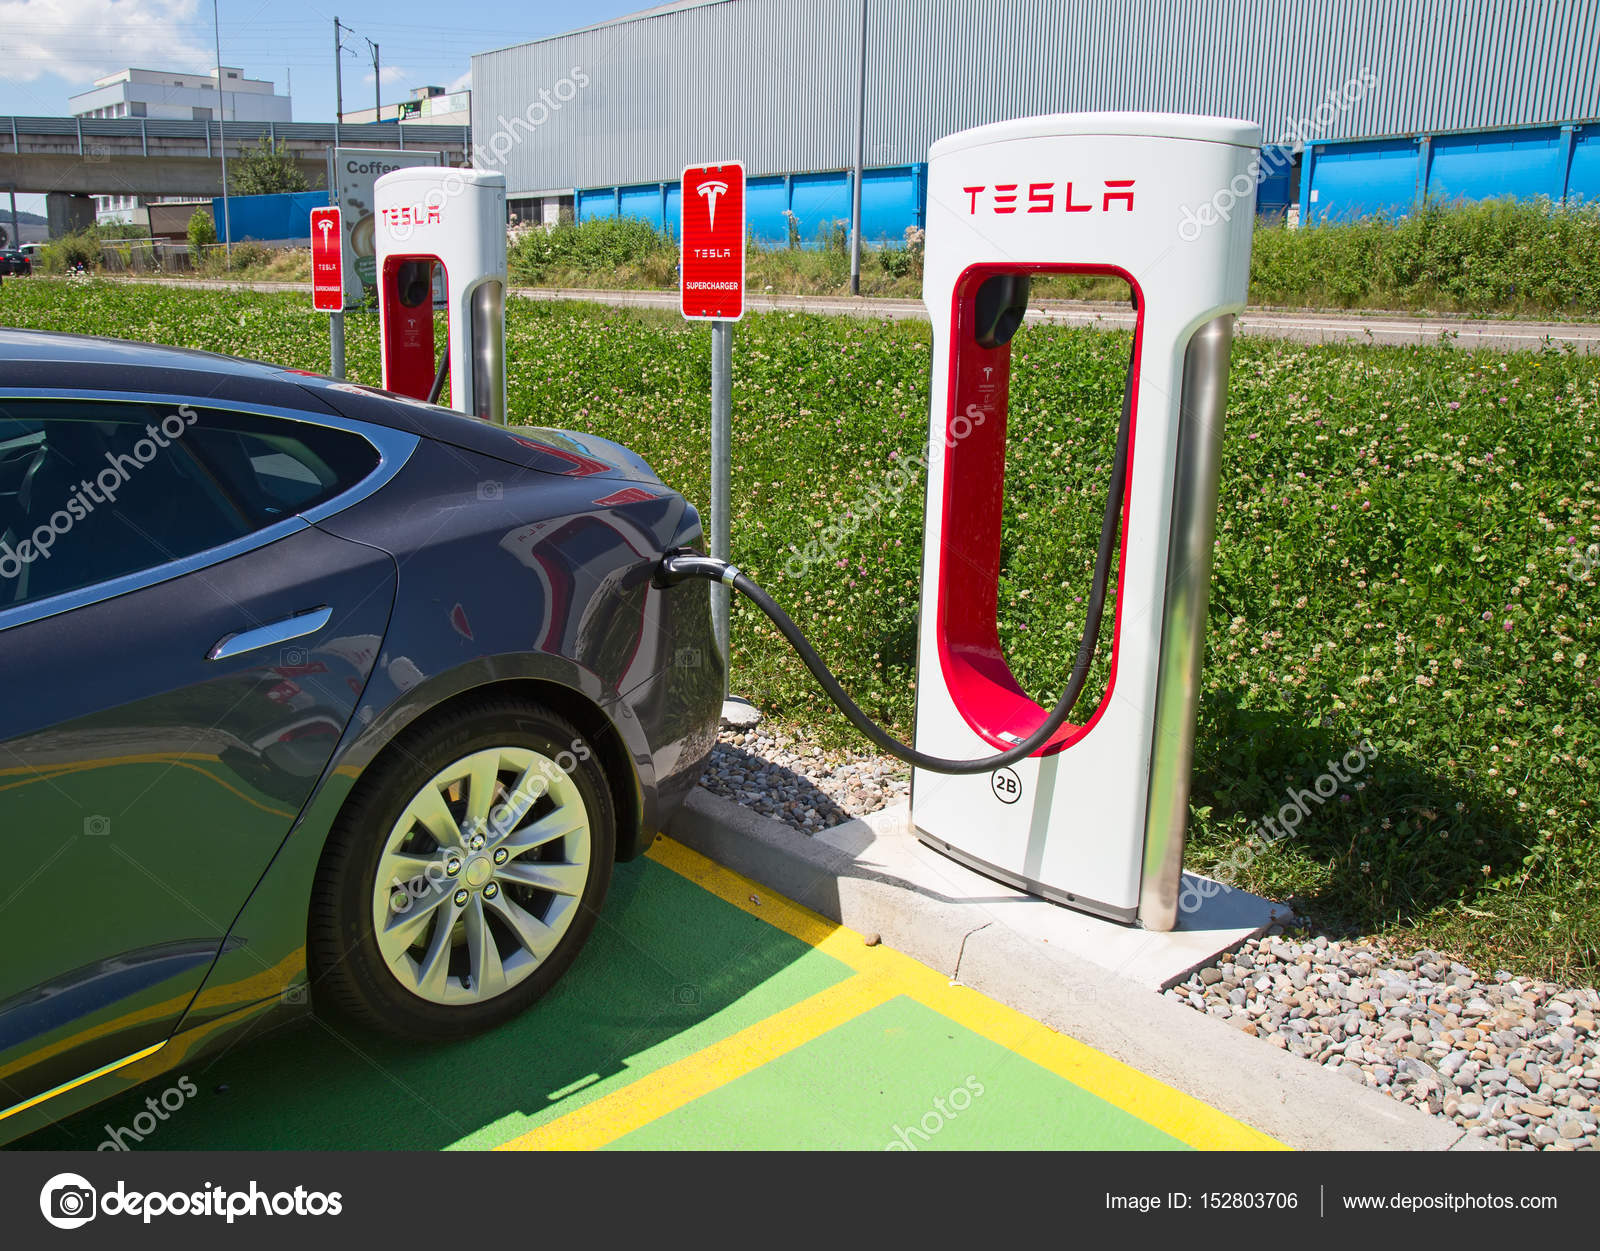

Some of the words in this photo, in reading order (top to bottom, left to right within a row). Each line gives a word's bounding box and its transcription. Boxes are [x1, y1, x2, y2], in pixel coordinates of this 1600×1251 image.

[963, 180, 1136, 215] TESLA
[382, 205, 441, 227] TESLA
[694, 249, 731, 258] TESLA
[318, 263, 336, 271] TESLA
[686, 281, 739, 290] SUPERCHARGER
[996, 775, 1017, 794] 2B
